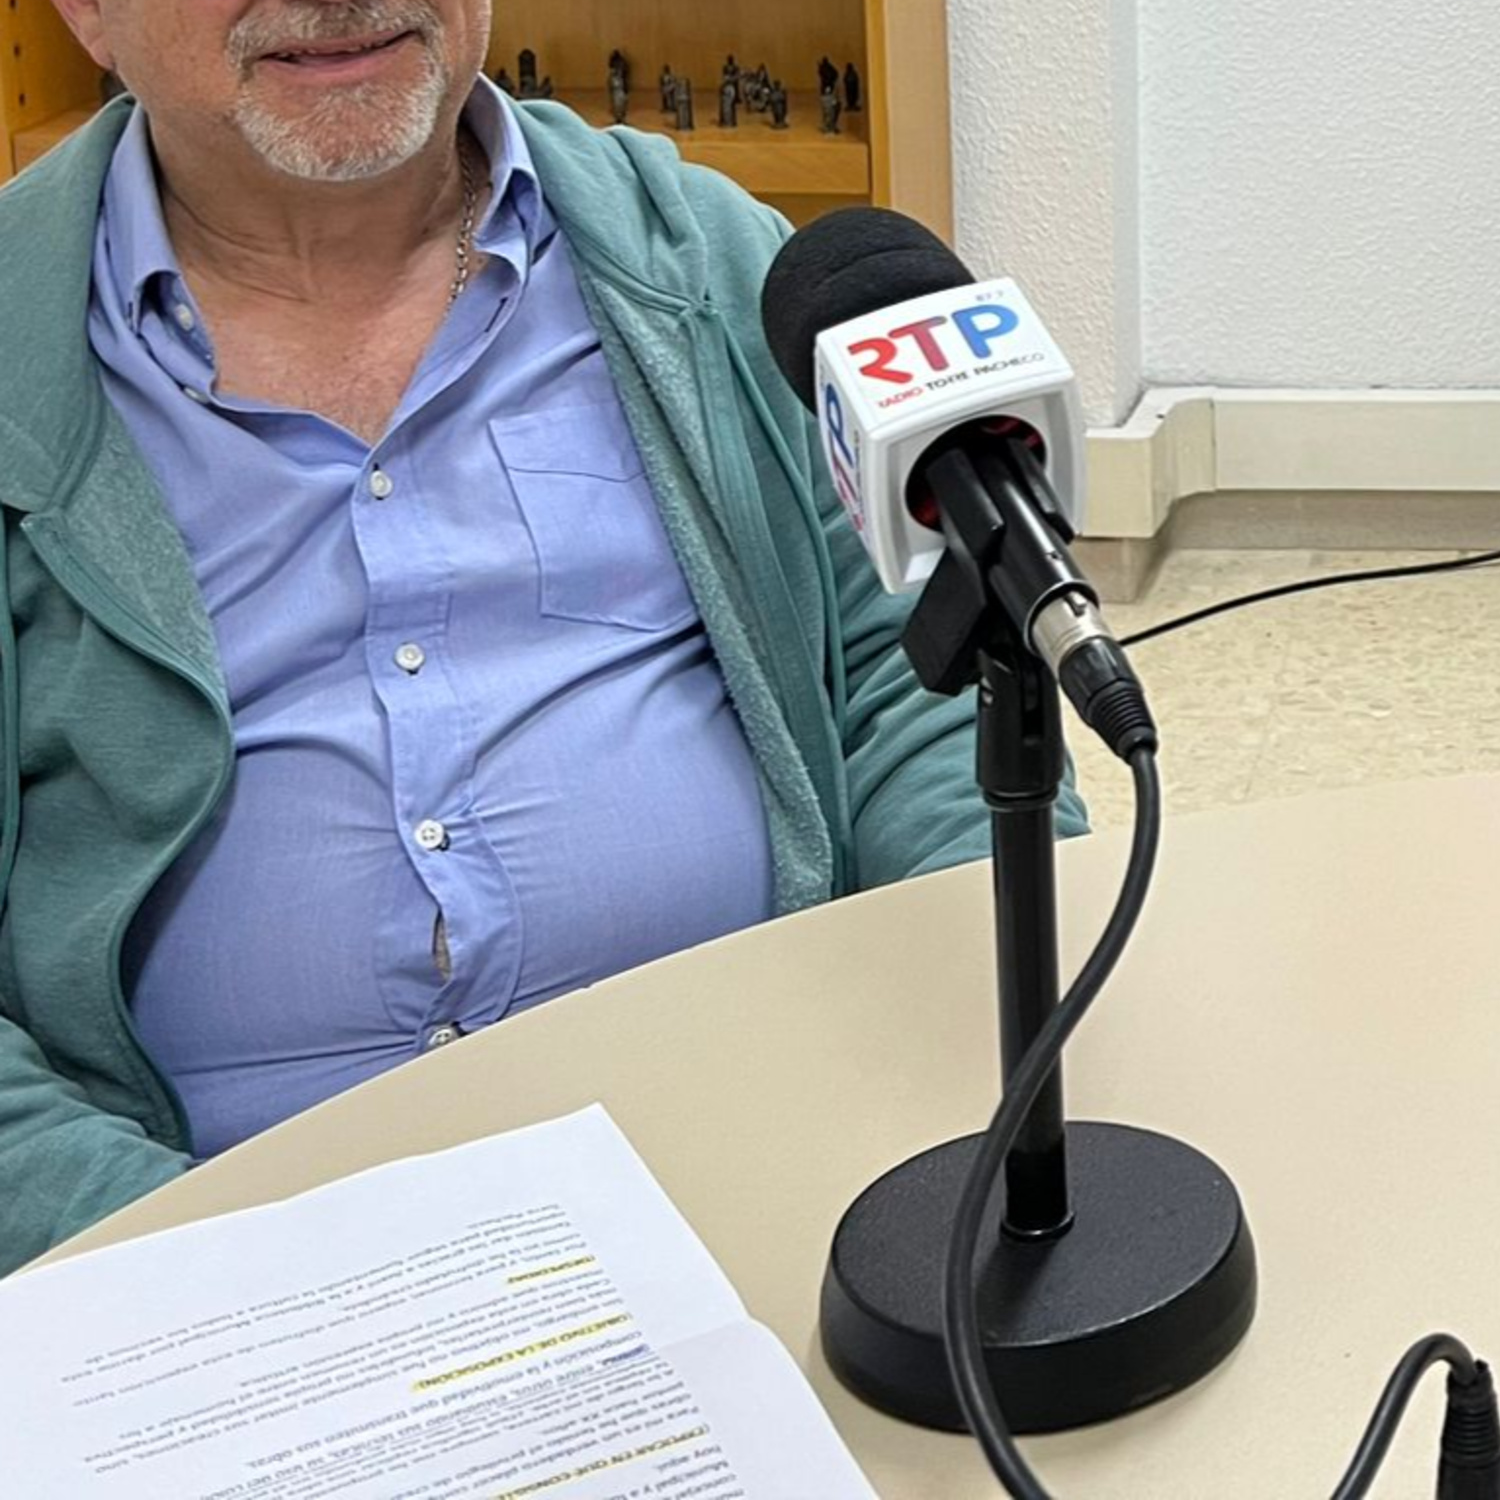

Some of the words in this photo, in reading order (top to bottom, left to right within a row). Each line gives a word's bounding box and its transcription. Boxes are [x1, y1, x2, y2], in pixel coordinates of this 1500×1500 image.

[847, 303, 1019, 384] RTP
[877, 386, 924, 408] RADIO
[925, 368, 969, 392] TORRE
[973, 352, 1046, 377] PACHECO
